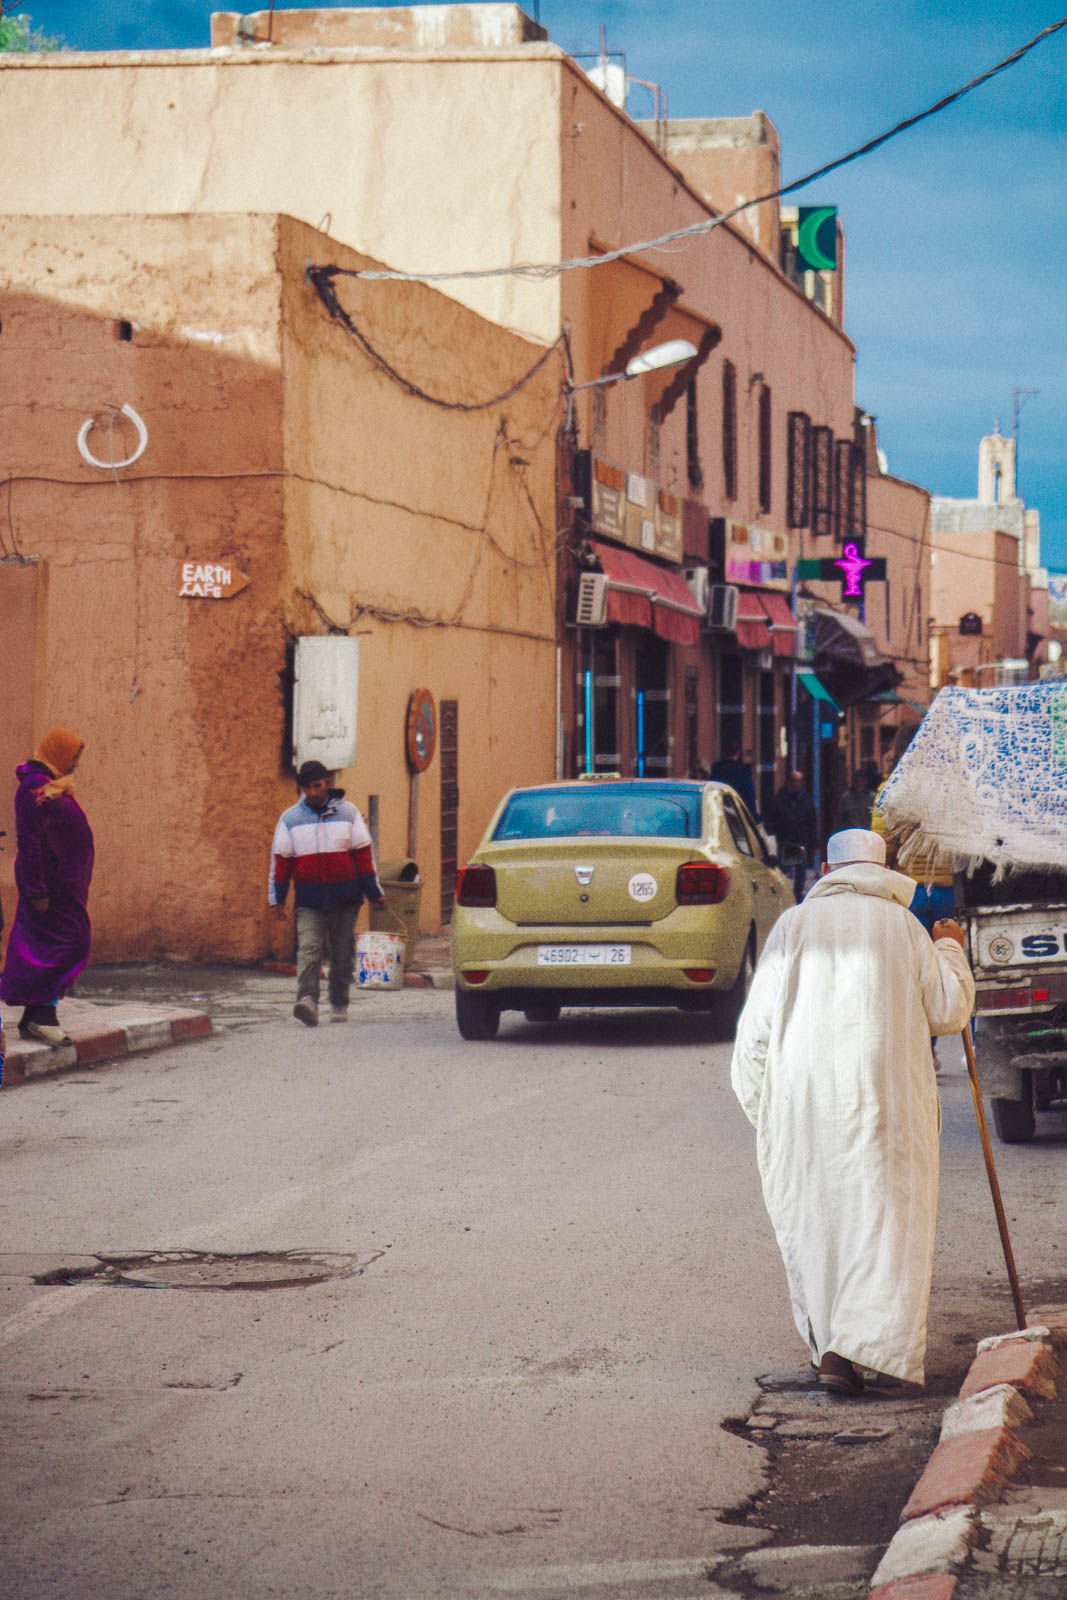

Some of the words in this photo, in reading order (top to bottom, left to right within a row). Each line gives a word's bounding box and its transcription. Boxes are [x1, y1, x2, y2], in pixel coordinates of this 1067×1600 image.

[182, 563, 231, 584] EARTH
[179, 582, 222, 599] CAFE
[631, 881, 654, 897] 1265
[543, 948, 578, 962] 46902
[610, 948, 625, 962] 26
